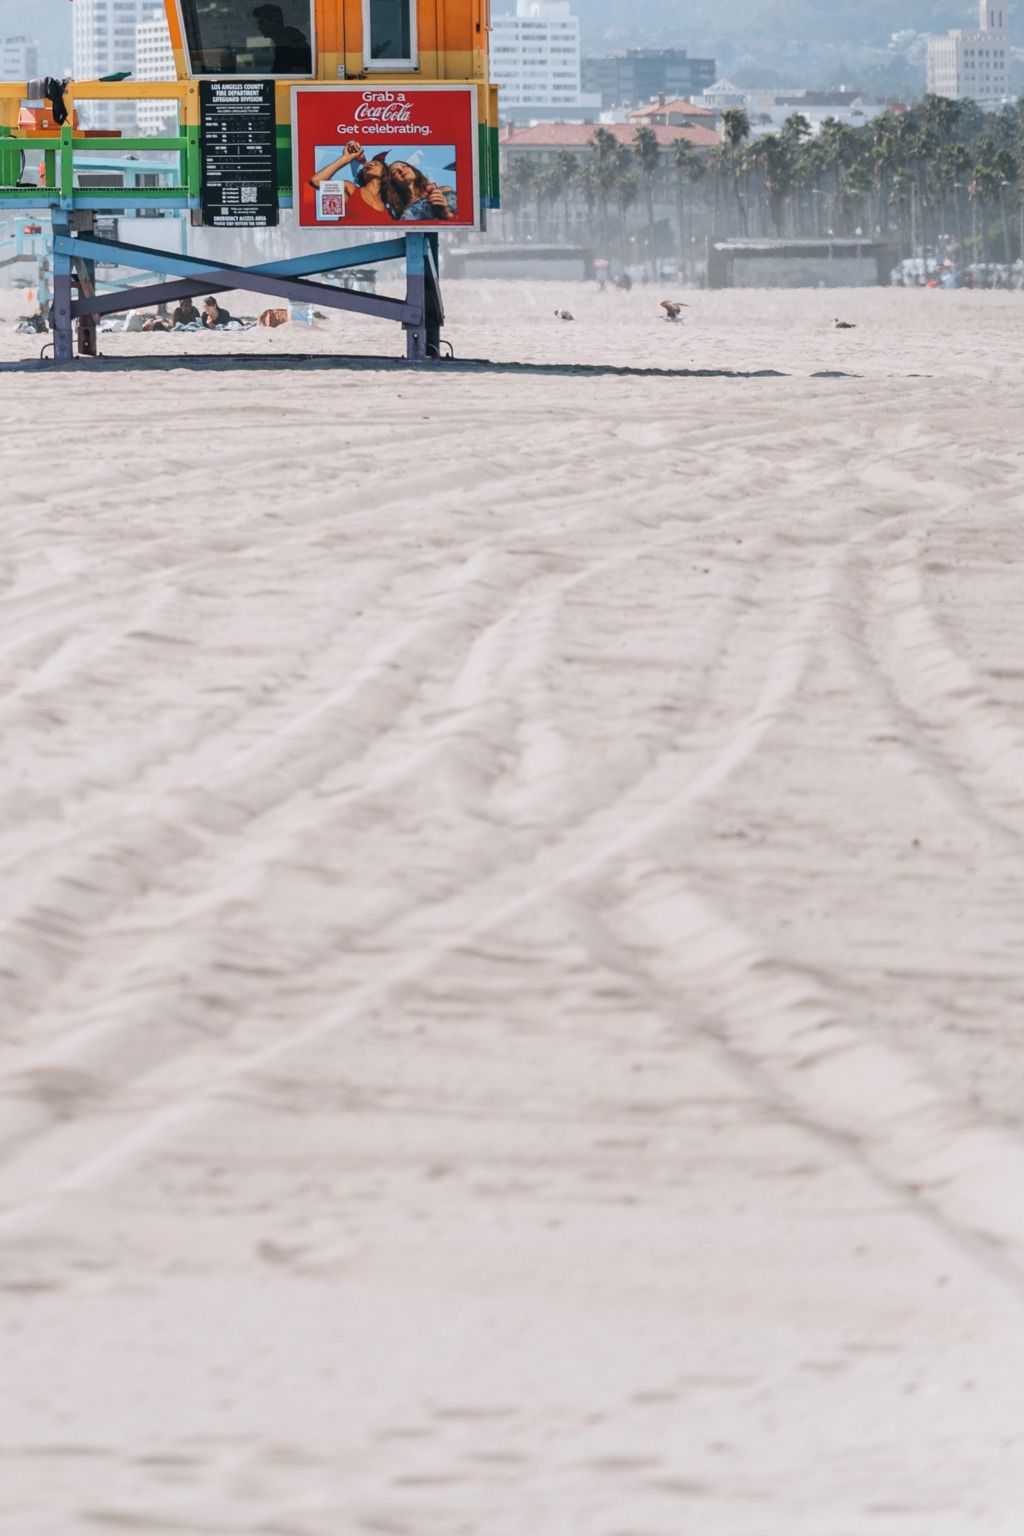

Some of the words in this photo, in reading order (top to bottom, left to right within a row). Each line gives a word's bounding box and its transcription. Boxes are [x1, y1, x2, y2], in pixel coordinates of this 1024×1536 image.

[362, 91, 394, 102] Grab
[396, 93, 406, 102] a
[354, 102, 414, 121] Coca-Cola
[337, 124, 360, 134] Get
[361, 123, 432, 135] celebrating.
